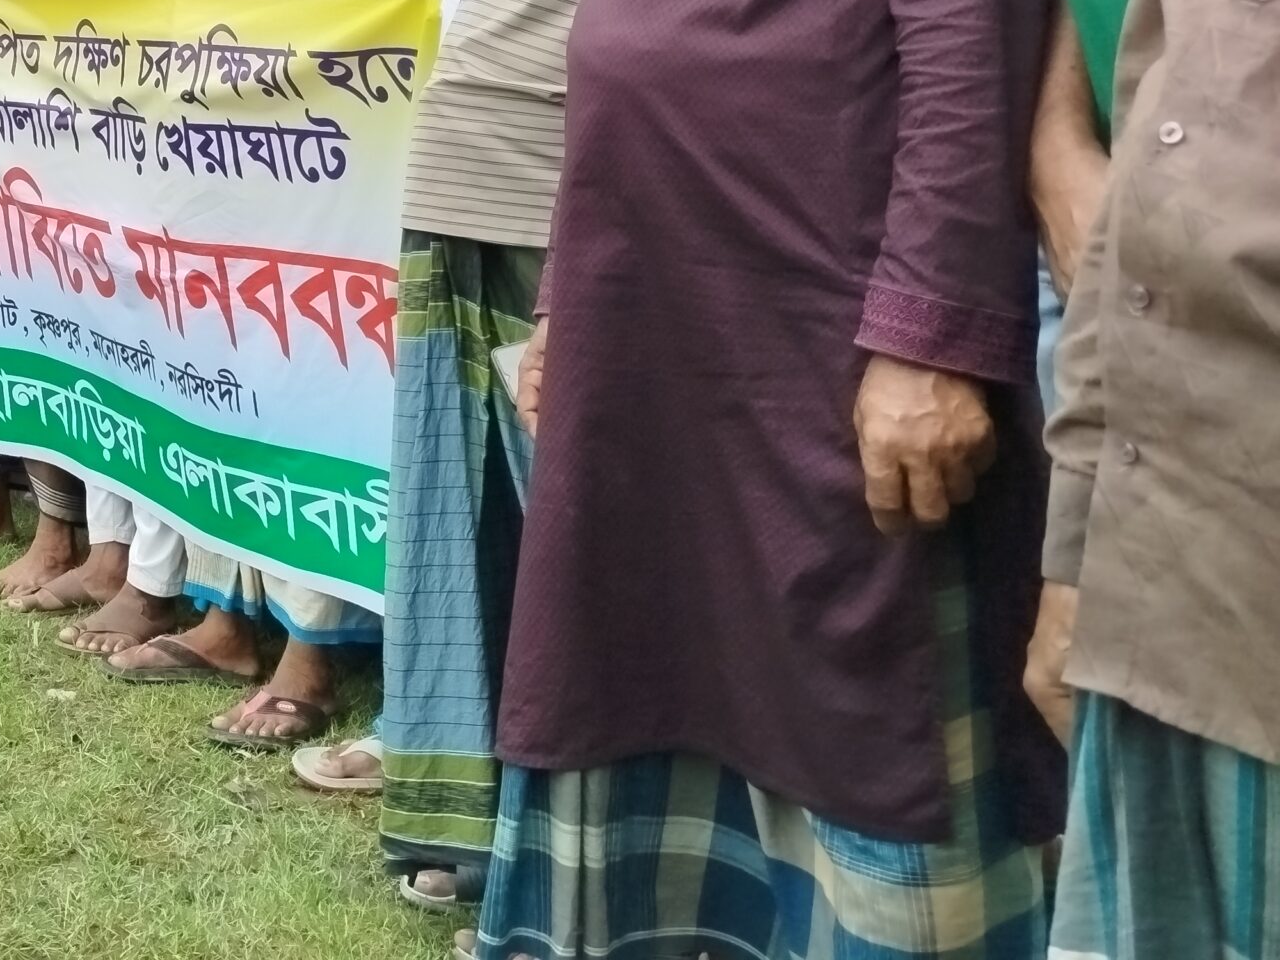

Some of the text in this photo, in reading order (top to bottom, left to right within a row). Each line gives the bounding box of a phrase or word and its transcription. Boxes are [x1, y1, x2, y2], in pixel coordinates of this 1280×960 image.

[53, 18, 131, 87] দক্ষিণ
[306, 46, 419, 109] হতে
[89, 96, 147, 176] বাড়ি
[156, 107, 351, 184] খেয়াঘাটে
[121, 224, 400, 378] মানববন্ধ
